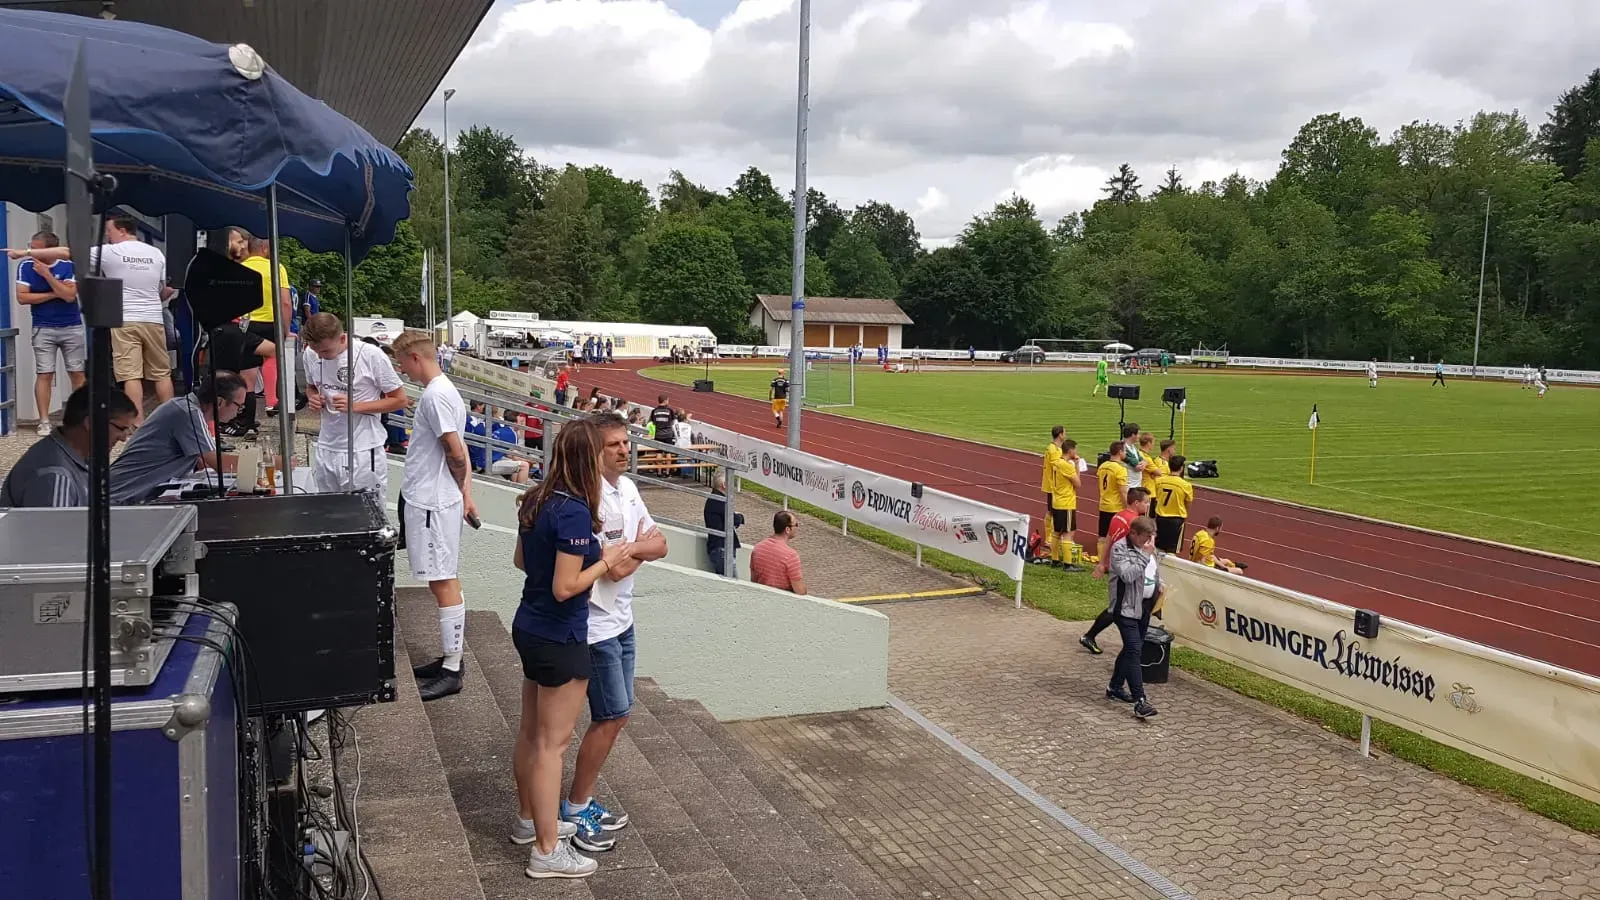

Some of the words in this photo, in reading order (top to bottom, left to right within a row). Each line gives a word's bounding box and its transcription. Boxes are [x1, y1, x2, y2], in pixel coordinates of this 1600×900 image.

[772, 458, 804, 486] ERDINGER
[1103, 473, 1108, 490] 6
[867, 488, 912, 523] ERDINGER
[1162, 488, 1173, 506] 7
[1190, 540, 1195, 555] 8
[1225, 606, 1328, 669] ERDINGER
[1327, 629, 1436, 702] Urweisse
